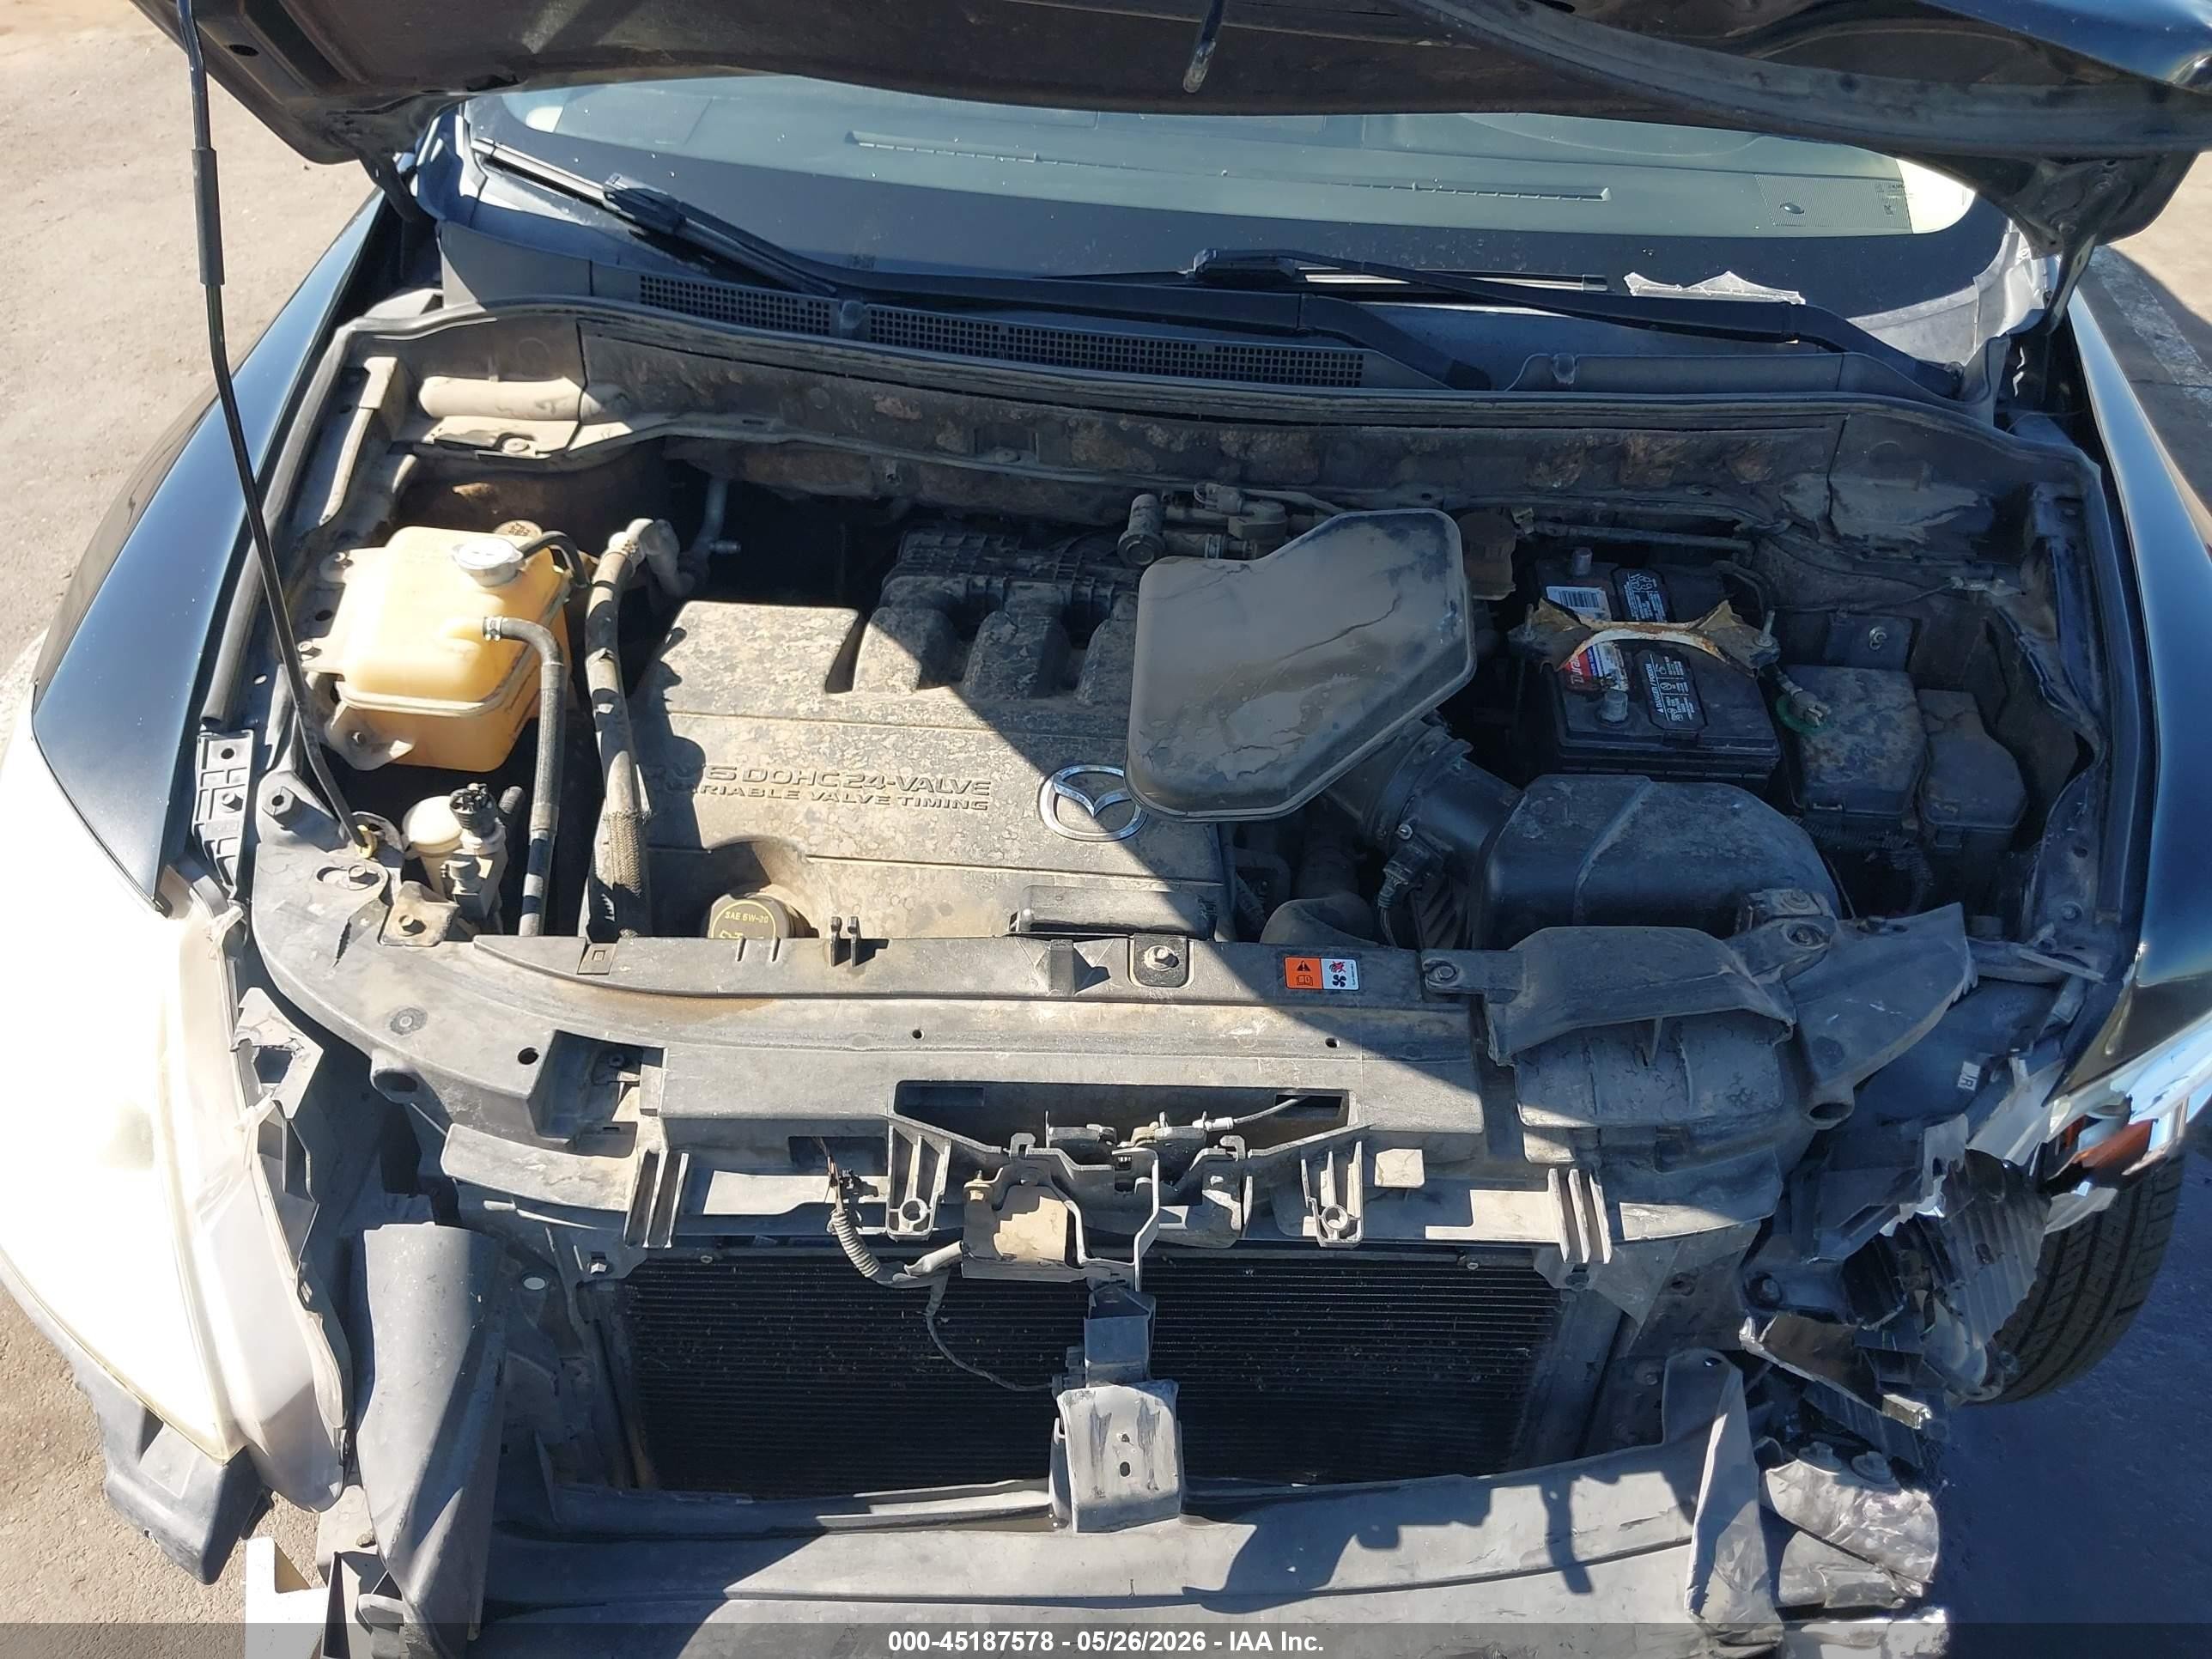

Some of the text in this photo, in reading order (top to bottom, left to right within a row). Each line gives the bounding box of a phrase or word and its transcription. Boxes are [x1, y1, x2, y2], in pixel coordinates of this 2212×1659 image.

[1644, 663, 1656, 682] POISON
[1651, 687, 1663, 708] DANGER
[742, 769, 840, 787] DOHC
[843, 773, 991, 797] 24-VALVE
[811, 791, 891, 805] VALVE
[897, 797, 988, 811] TIMING
[725, 911, 741, 921] SAE
